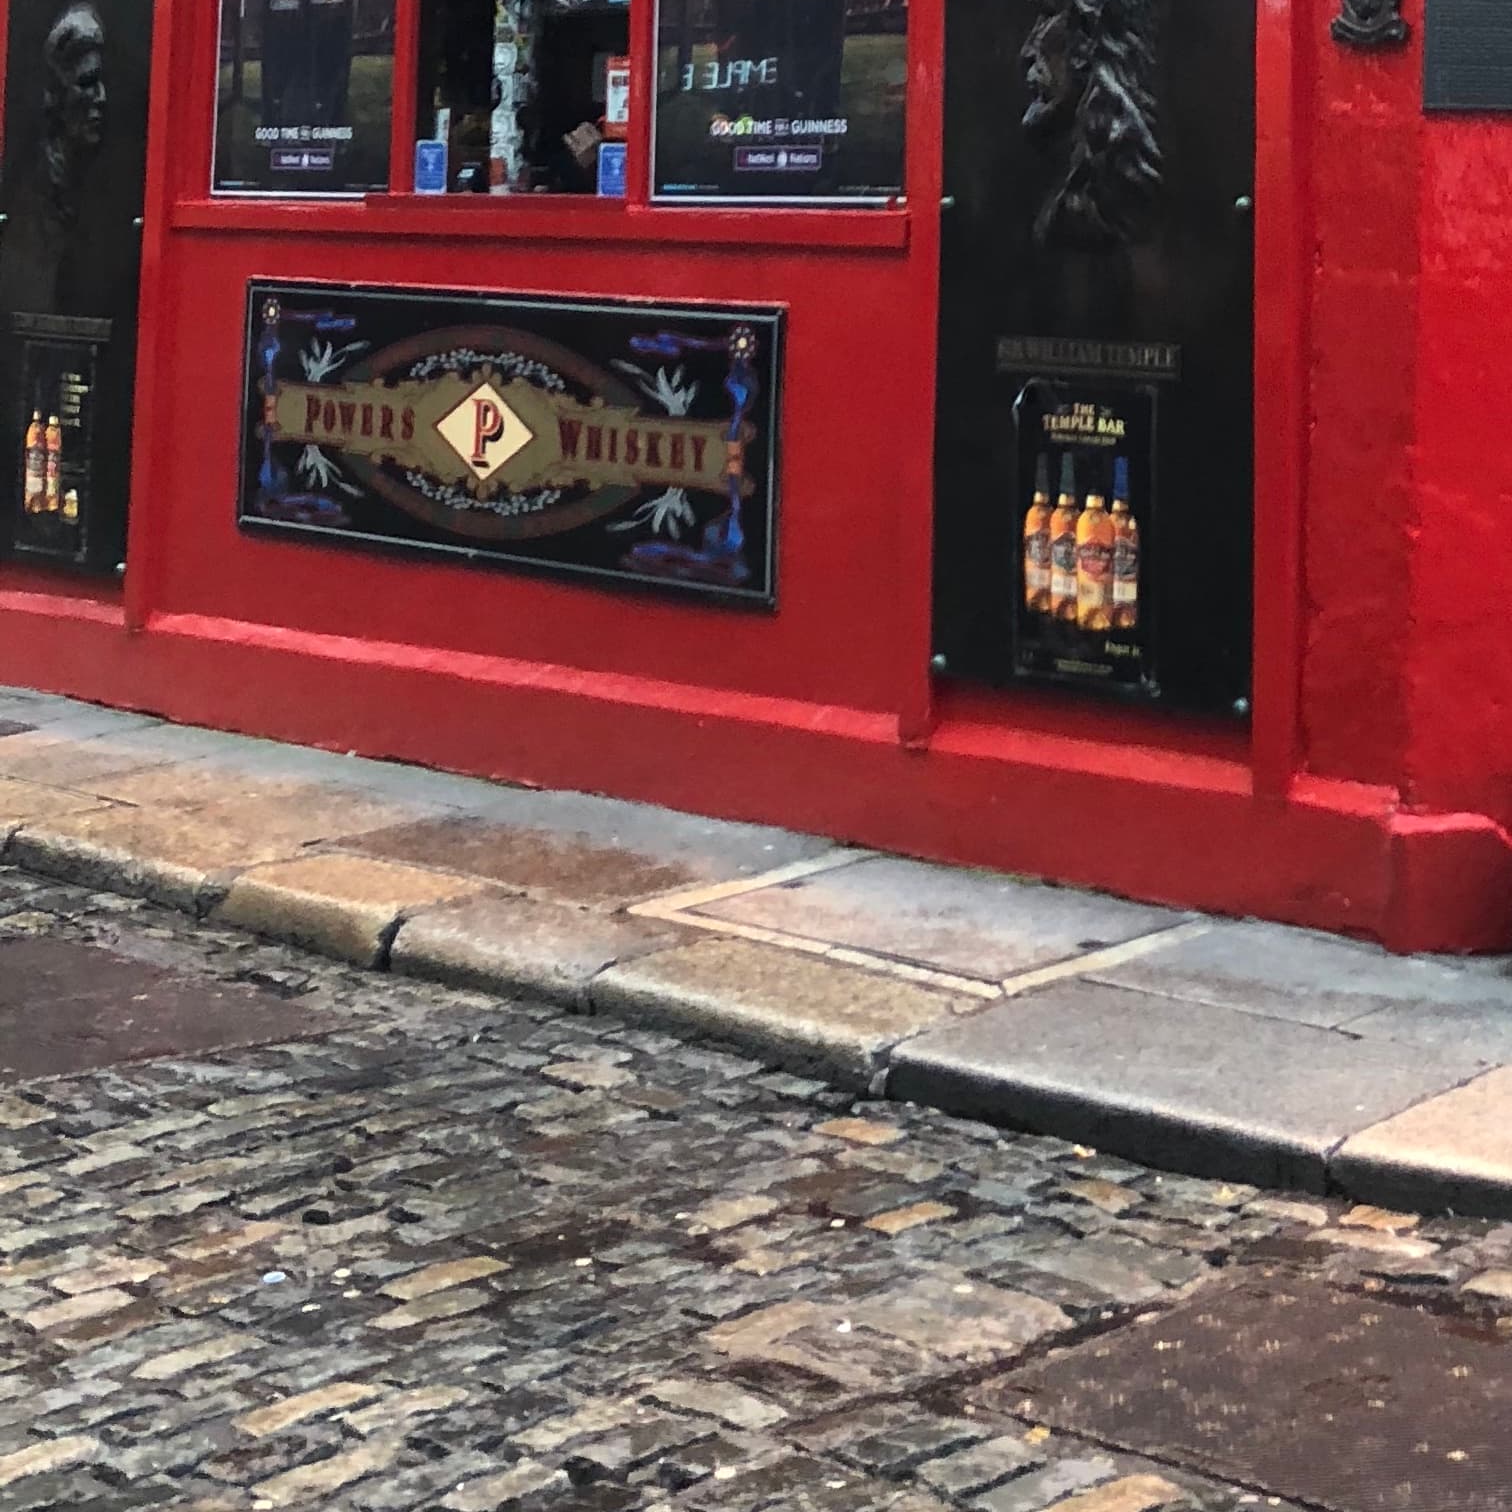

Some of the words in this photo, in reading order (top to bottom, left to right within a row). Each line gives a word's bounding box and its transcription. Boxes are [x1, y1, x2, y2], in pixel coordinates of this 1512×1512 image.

[791, 118, 848, 135] GUINNESS
[1073, 402, 1095, 416] THE
[304, 395, 416, 442] POWERS
[558, 418, 708, 473] WHISKEY
[472, 397, 503, 466] P
[1042, 414, 1095, 433] TEMPLE
[1097, 417, 1126, 435] BAR
